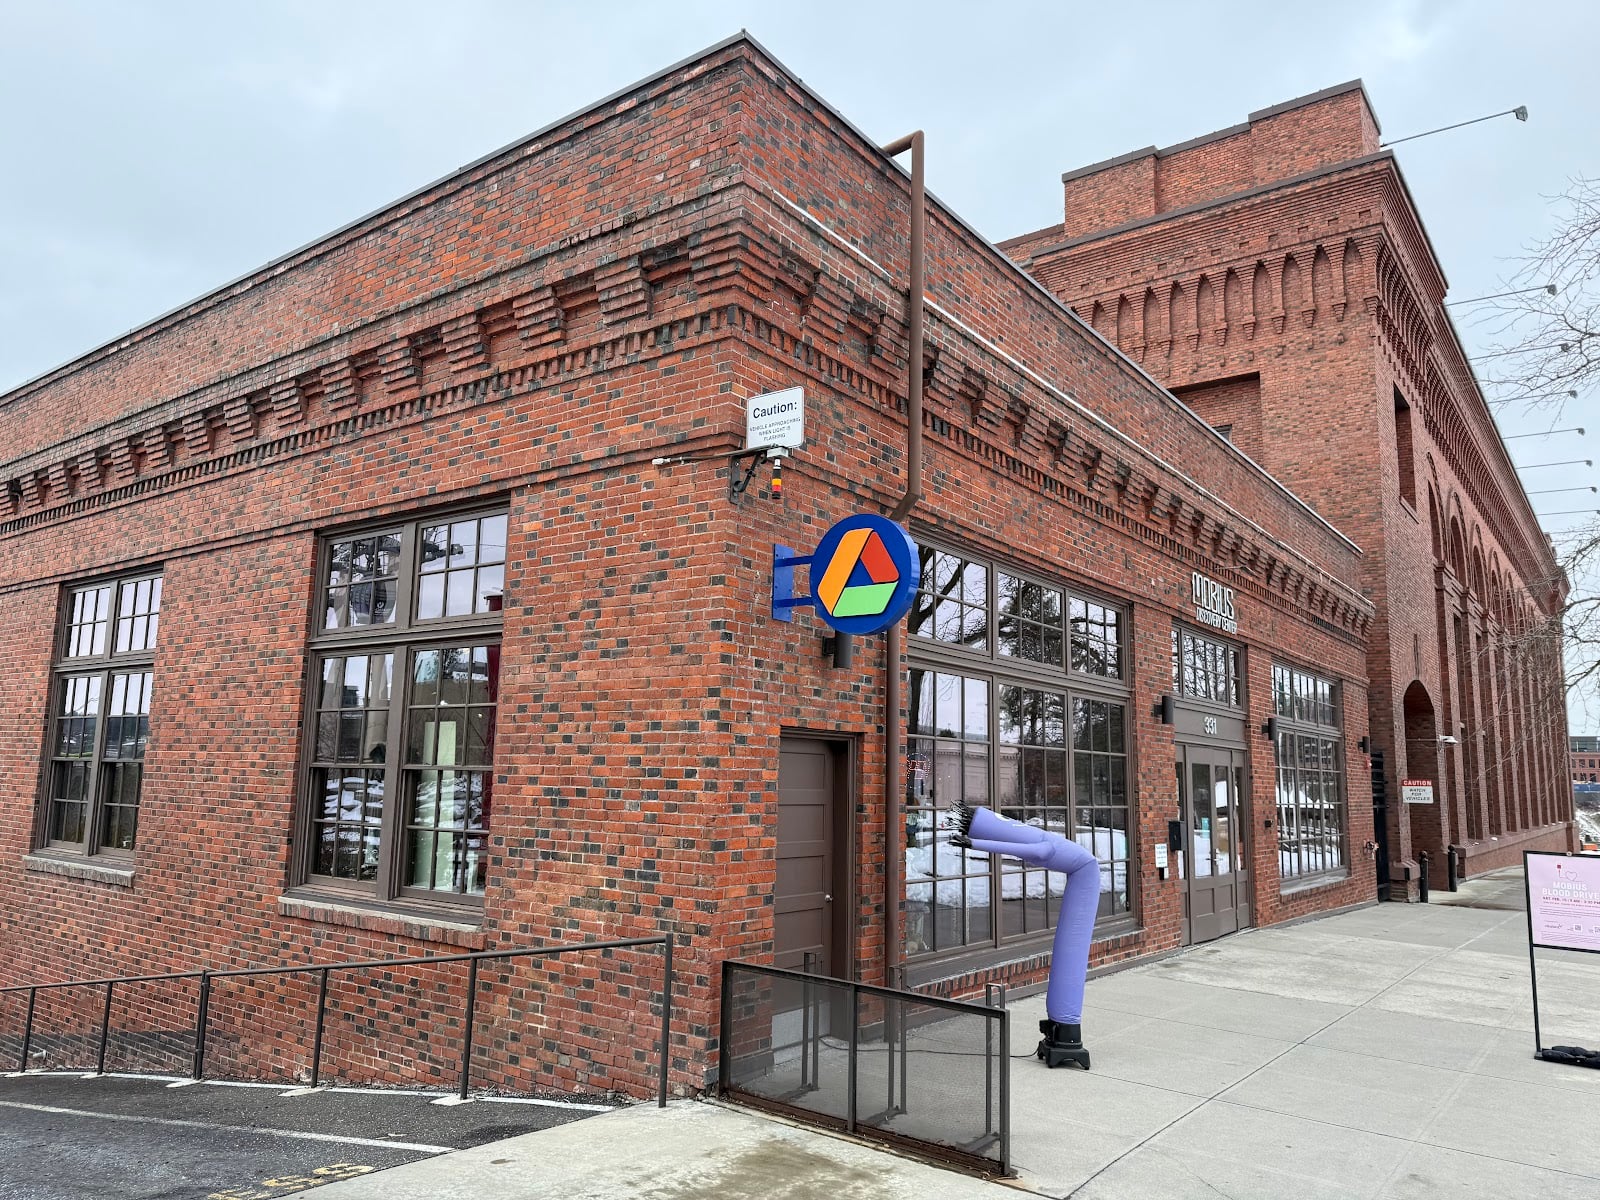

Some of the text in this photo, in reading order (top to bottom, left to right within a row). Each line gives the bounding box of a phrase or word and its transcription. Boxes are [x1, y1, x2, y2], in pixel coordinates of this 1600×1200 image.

[753, 402, 797, 418] Caution:
[1192, 572, 1234, 619] MOBIUS
[1204, 716, 1217, 734] 331
[1542, 888, 1600, 900] BLOOD DRIVE
[1553, 881, 1588, 891] MOBIUS
